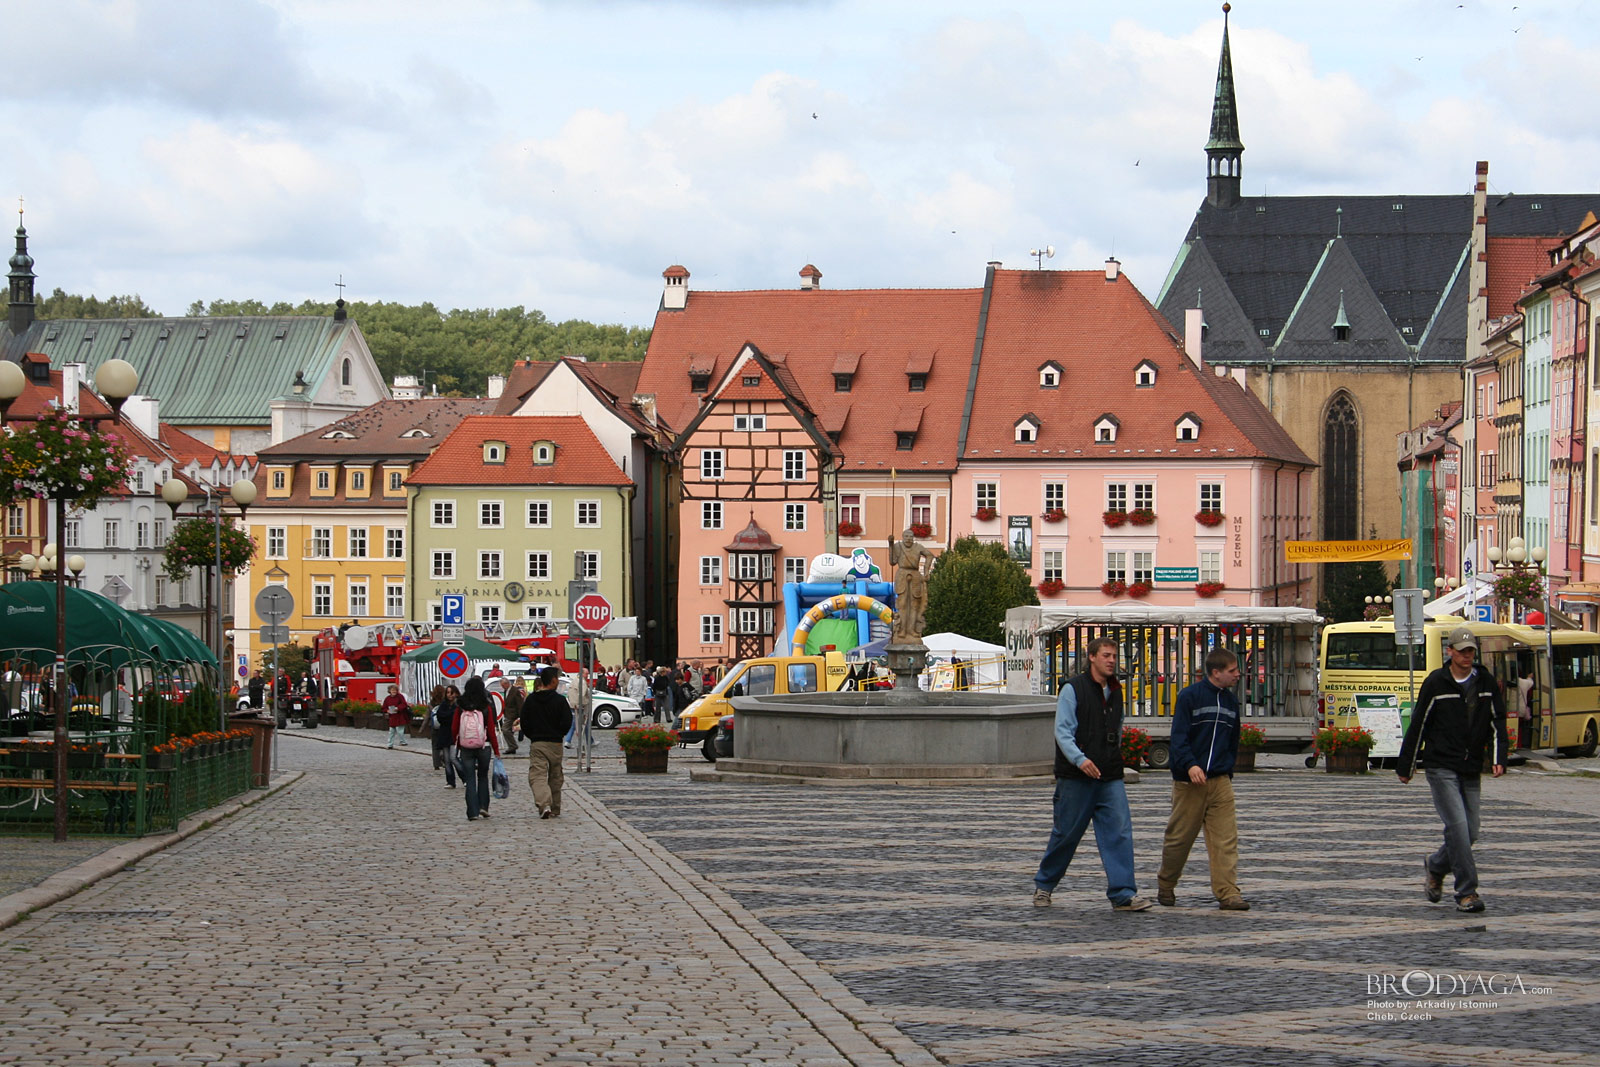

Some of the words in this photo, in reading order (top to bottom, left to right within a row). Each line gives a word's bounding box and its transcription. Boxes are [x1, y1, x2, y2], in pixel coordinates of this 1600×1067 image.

[1233, 516, 1242, 567] MUZEUM
[1287, 544, 1332, 553] CHEBSKÉ
[1335, 543, 1383, 553] VARHANNÍ
[435, 586, 500, 597] KAVÁRNA
[528, 587, 568, 597] ŠPALÍ
[446, 598, 460, 616] P
[576, 605, 609, 621] STOP
[802, 596, 856, 629] TEREA
[1477, 608, 1488, 622] P
[1008, 629, 1034, 657] Cyklo
